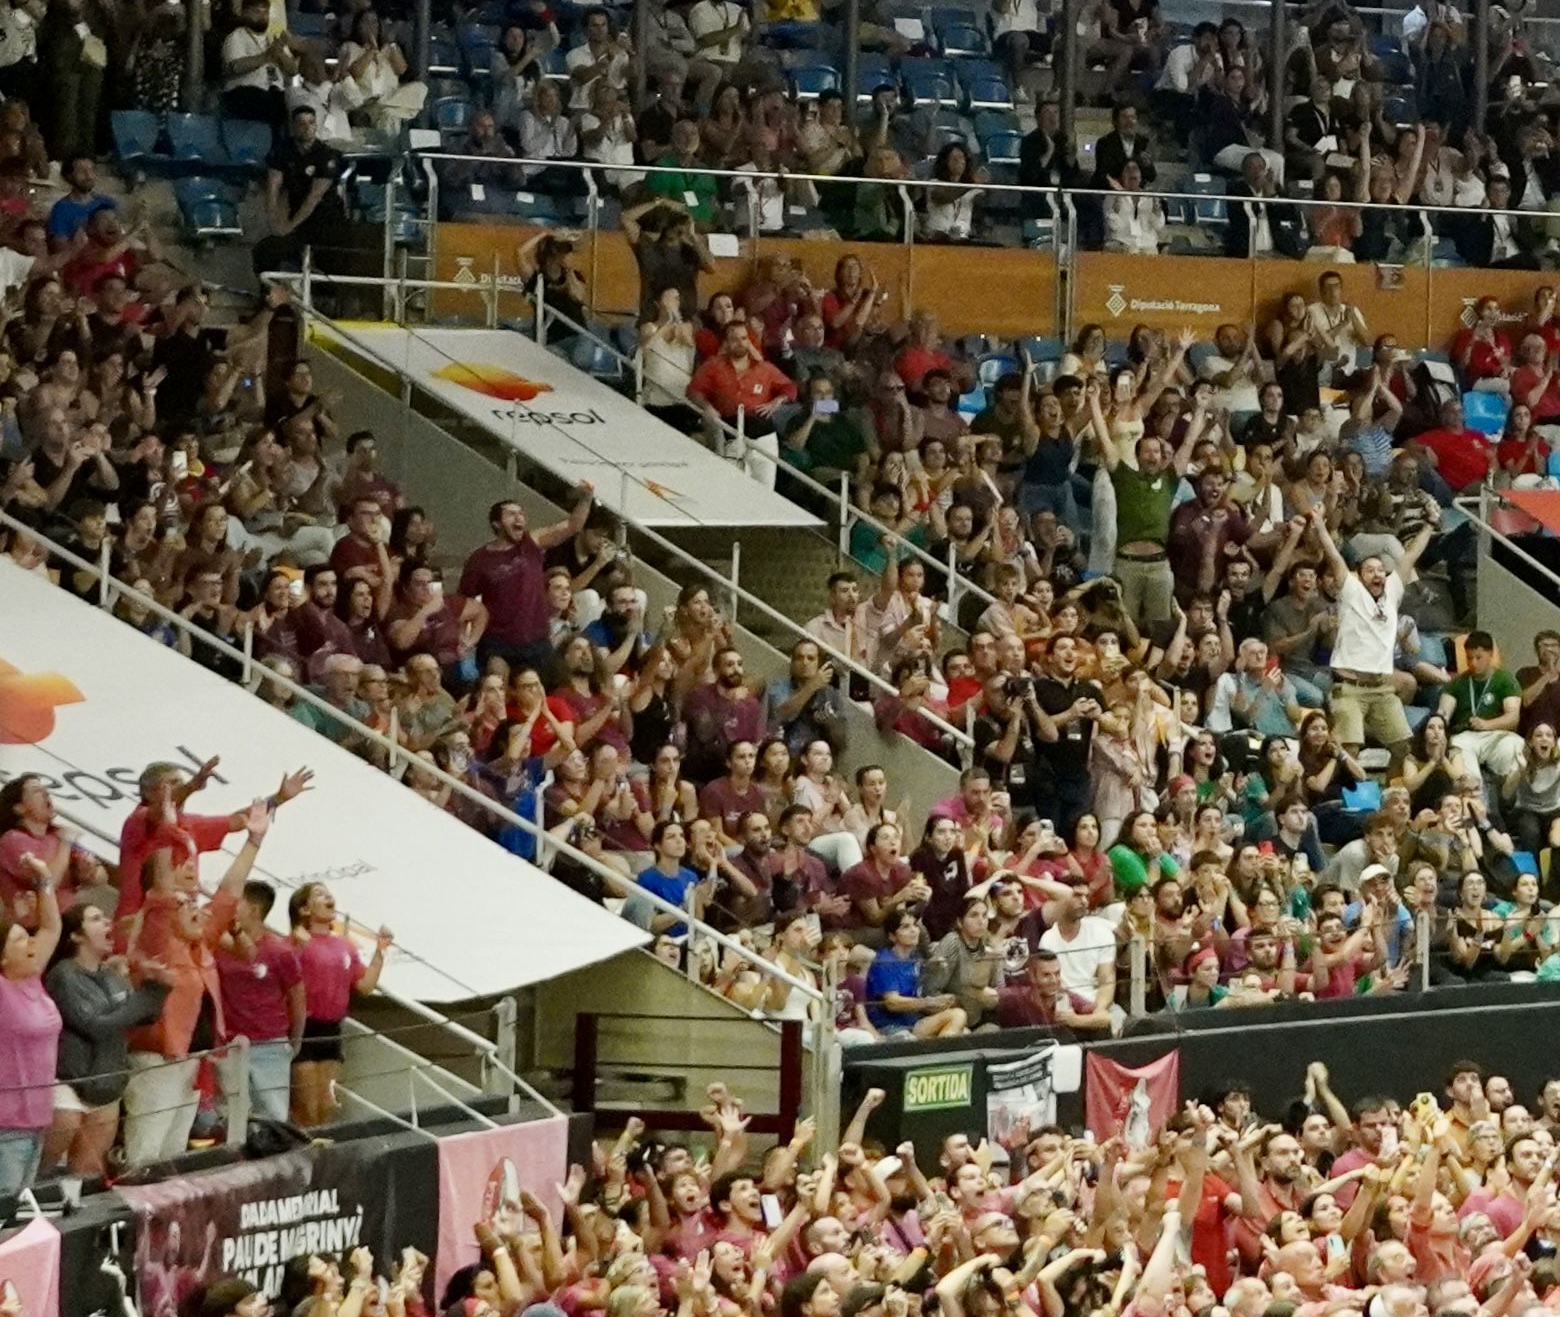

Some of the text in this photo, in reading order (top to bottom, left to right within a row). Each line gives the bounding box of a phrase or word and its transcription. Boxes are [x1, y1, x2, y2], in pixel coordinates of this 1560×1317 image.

[491, 408, 606, 426] repsol
[907, 1072, 968, 1105] SORTIDA
[254, 1231, 279, 1266] DE
